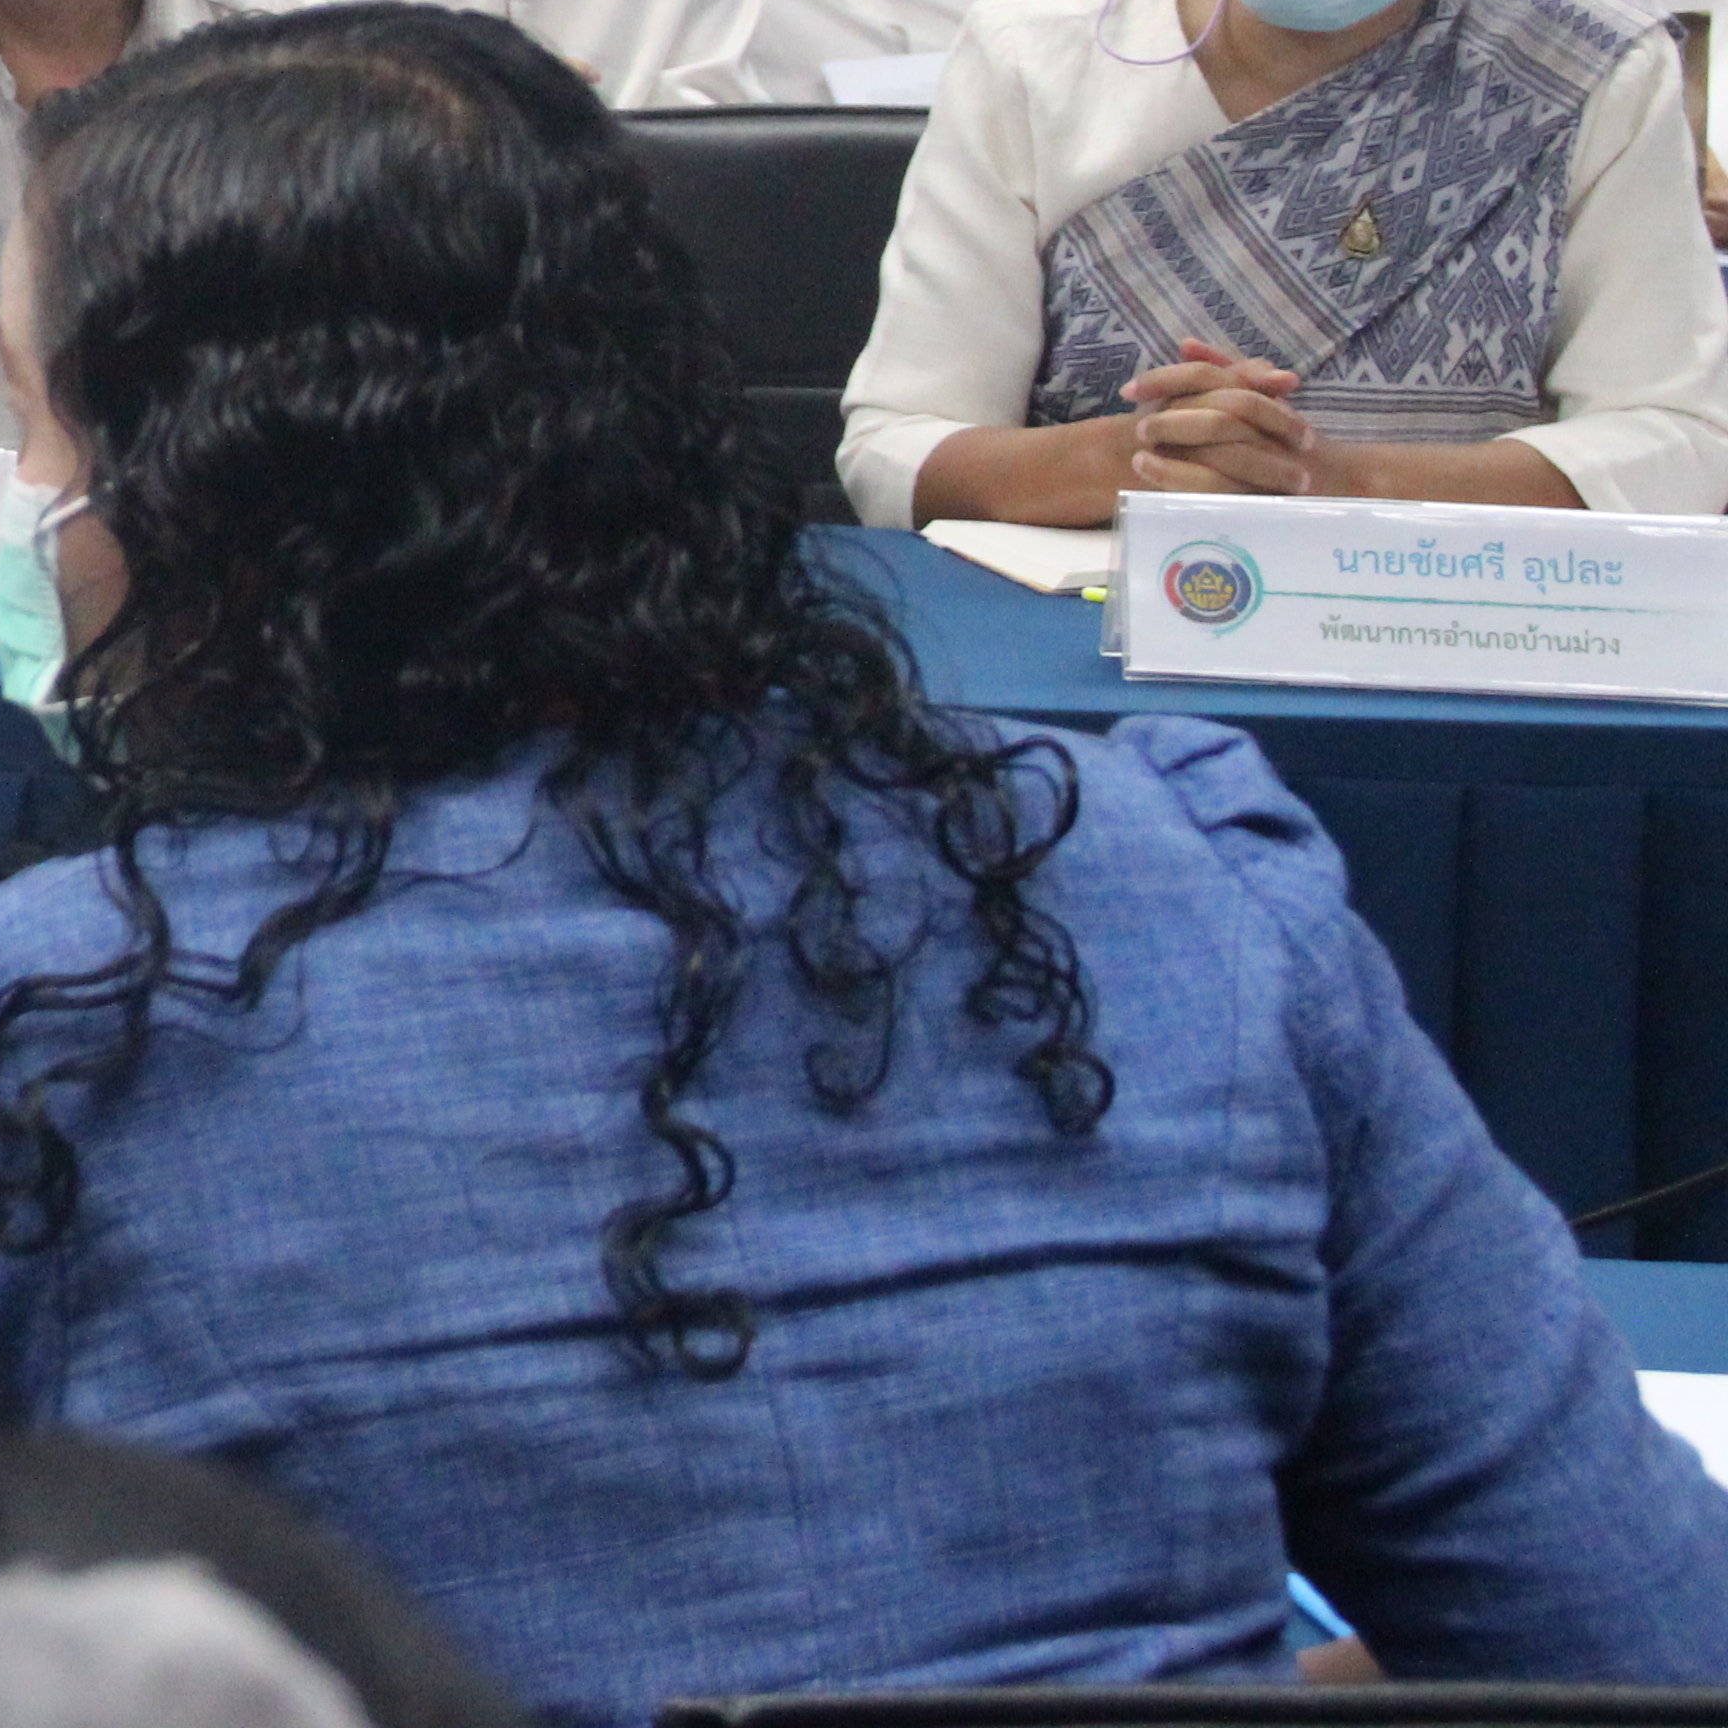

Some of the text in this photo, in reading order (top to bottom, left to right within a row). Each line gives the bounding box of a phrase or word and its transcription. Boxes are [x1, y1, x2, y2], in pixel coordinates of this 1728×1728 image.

[1332, 537, 1624, 595] นายชัยศรี อุปละ
[1318, 613, 1622, 656] พัฒนาการอำเภอบ้านม่วง
